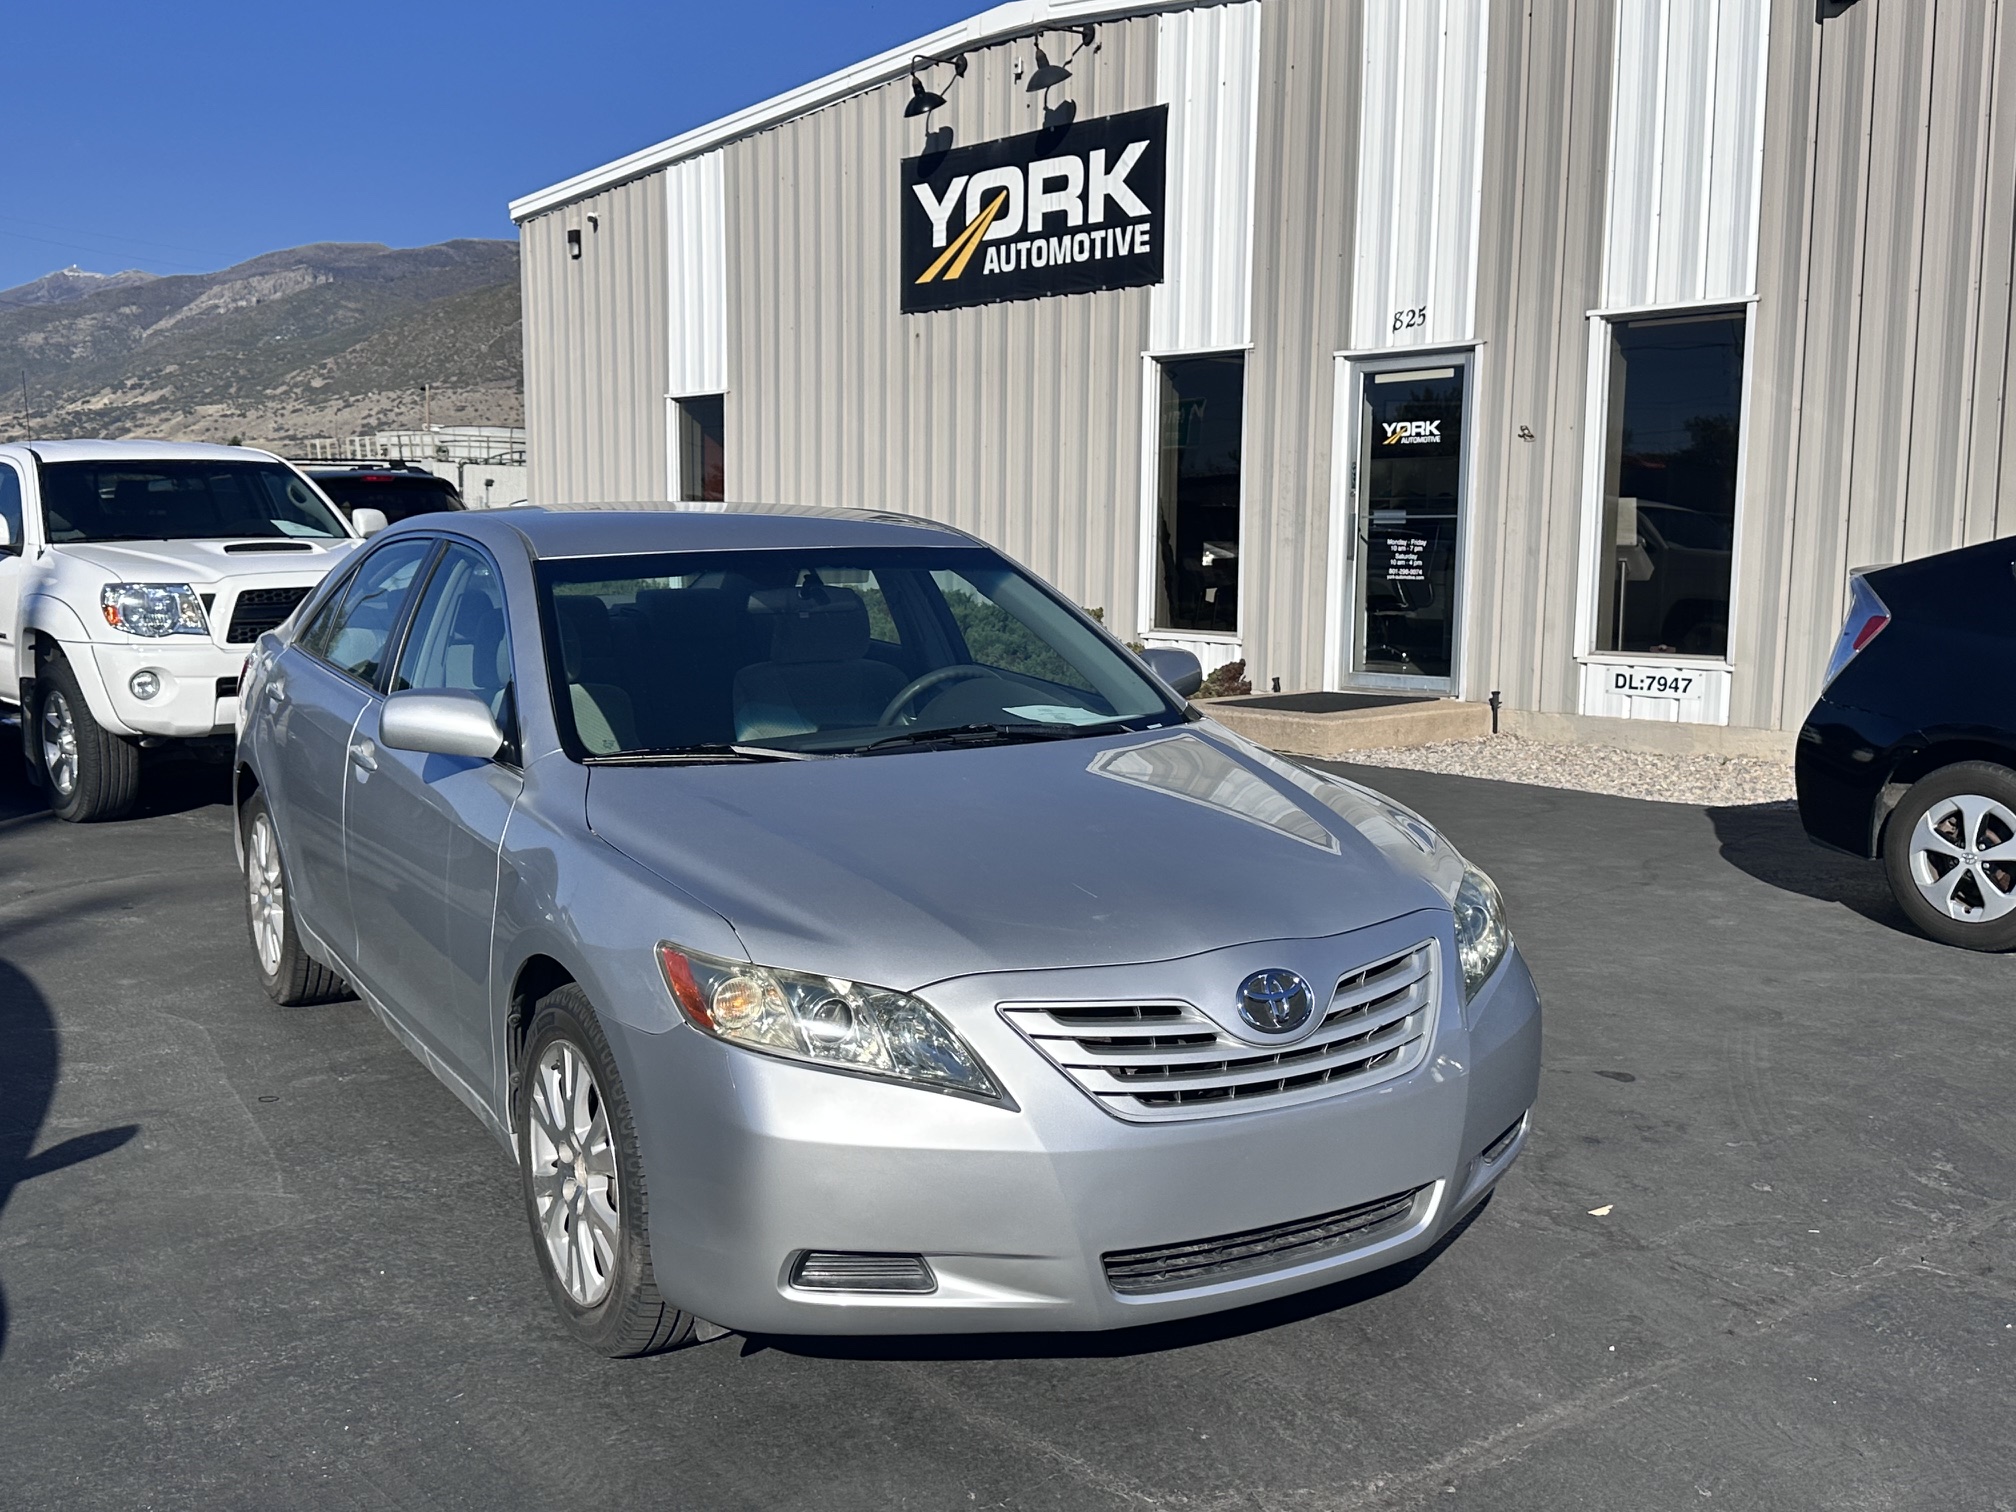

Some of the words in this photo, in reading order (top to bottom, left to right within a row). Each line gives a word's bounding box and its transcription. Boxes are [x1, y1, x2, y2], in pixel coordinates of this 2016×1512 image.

[912, 139, 1152, 248] YORK
[983, 223, 1150, 274] AUTOMOTIVE
[1392, 305, 1427, 334] 825
[1382, 419, 1441, 437] YORK
[1400, 435, 1441, 444] AUTOMOTIVE
[1411, 539, 1427, 547] Friday
[1615, 673, 1693, 693] DL:7947
